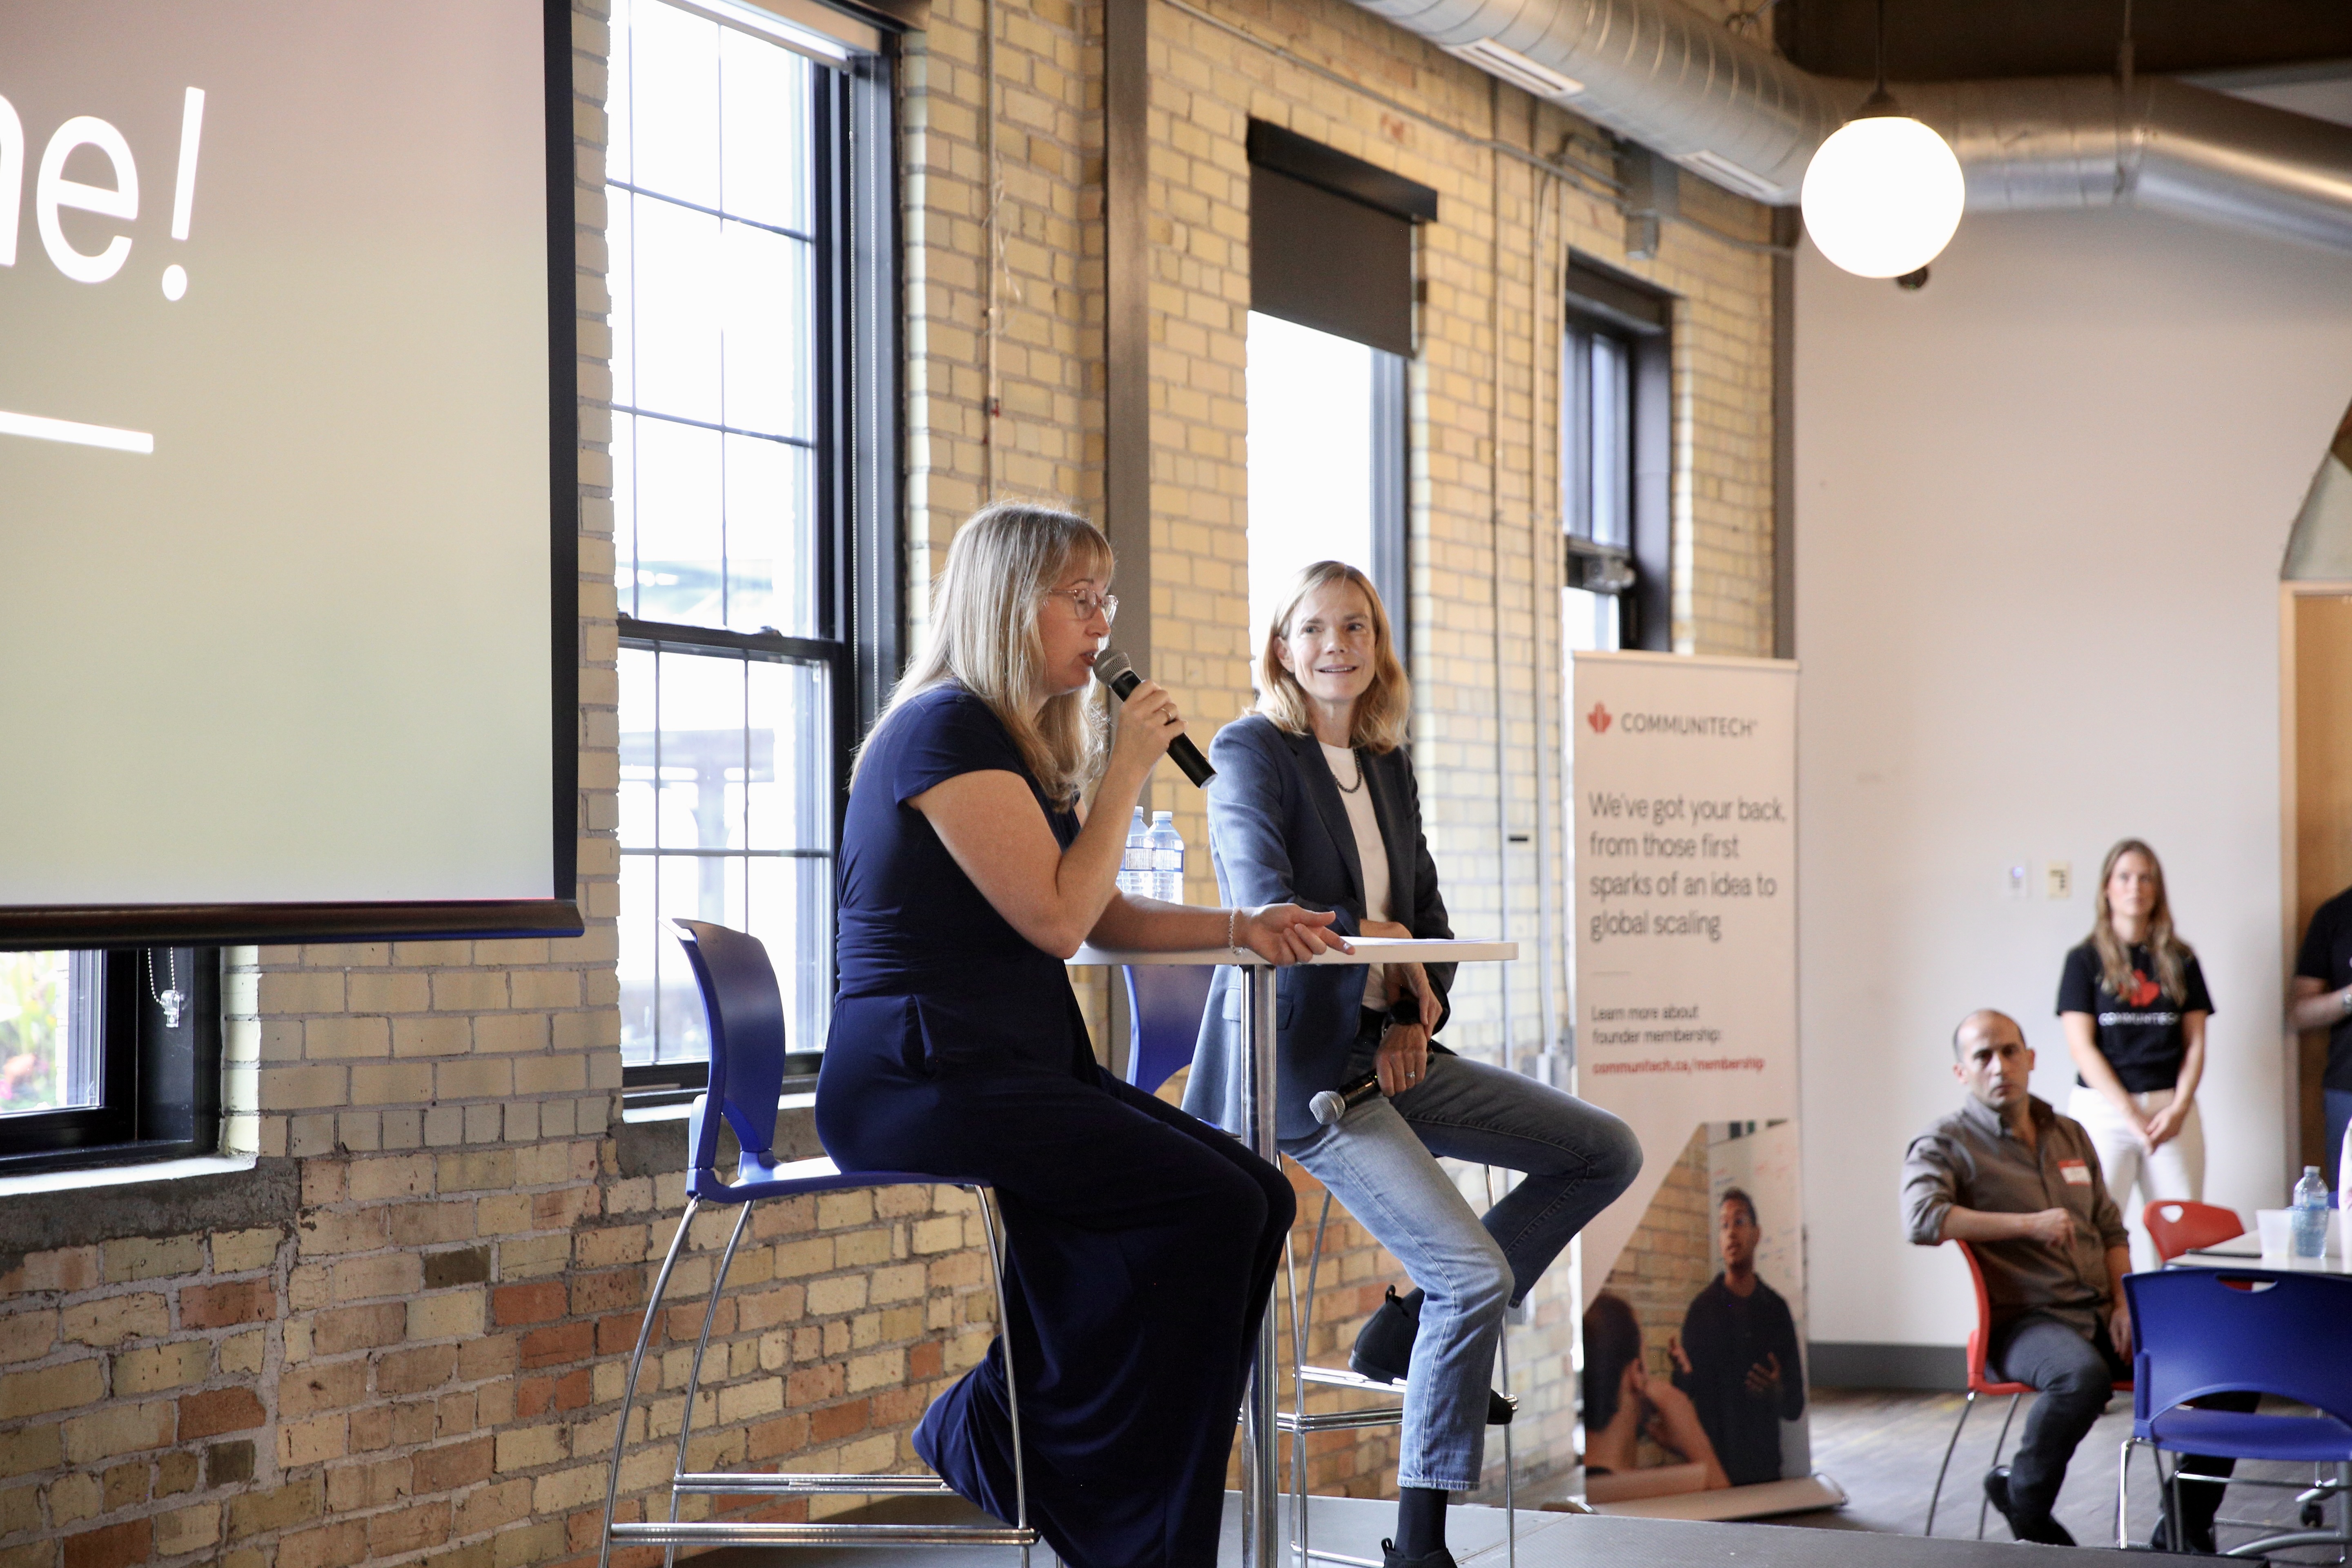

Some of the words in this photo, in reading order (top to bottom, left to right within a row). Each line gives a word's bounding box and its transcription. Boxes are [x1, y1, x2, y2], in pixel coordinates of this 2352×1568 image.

[1588, 791, 1648, 817] We've
[1653, 794, 1683, 826] got
[1689, 800, 1731, 826] your
[1737, 795, 1786, 823] back,
[1590, 831, 1637, 857] from
[1642, 831, 1697, 858] those
[1702, 832, 1739, 858] first
[1590, 870, 1652, 902] sparks
[1656, 871, 1679, 896] of
[1684, 875, 1707, 896] an
[1711, 871, 1752, 897] idea
[1757, 871, 1777, 898] to
[1590, 909, 1649, 942] global
[1653, 909, 1722, 943] scaling
[1591, 1005, 1626, 1021] Learn
[1628, 1007, 1658, 1020] more
[1662, 1005, 1699, 1020] about
[1592, 1028, 1641, 1044] founder
[1644, 1027, 1721, 1046] membership
